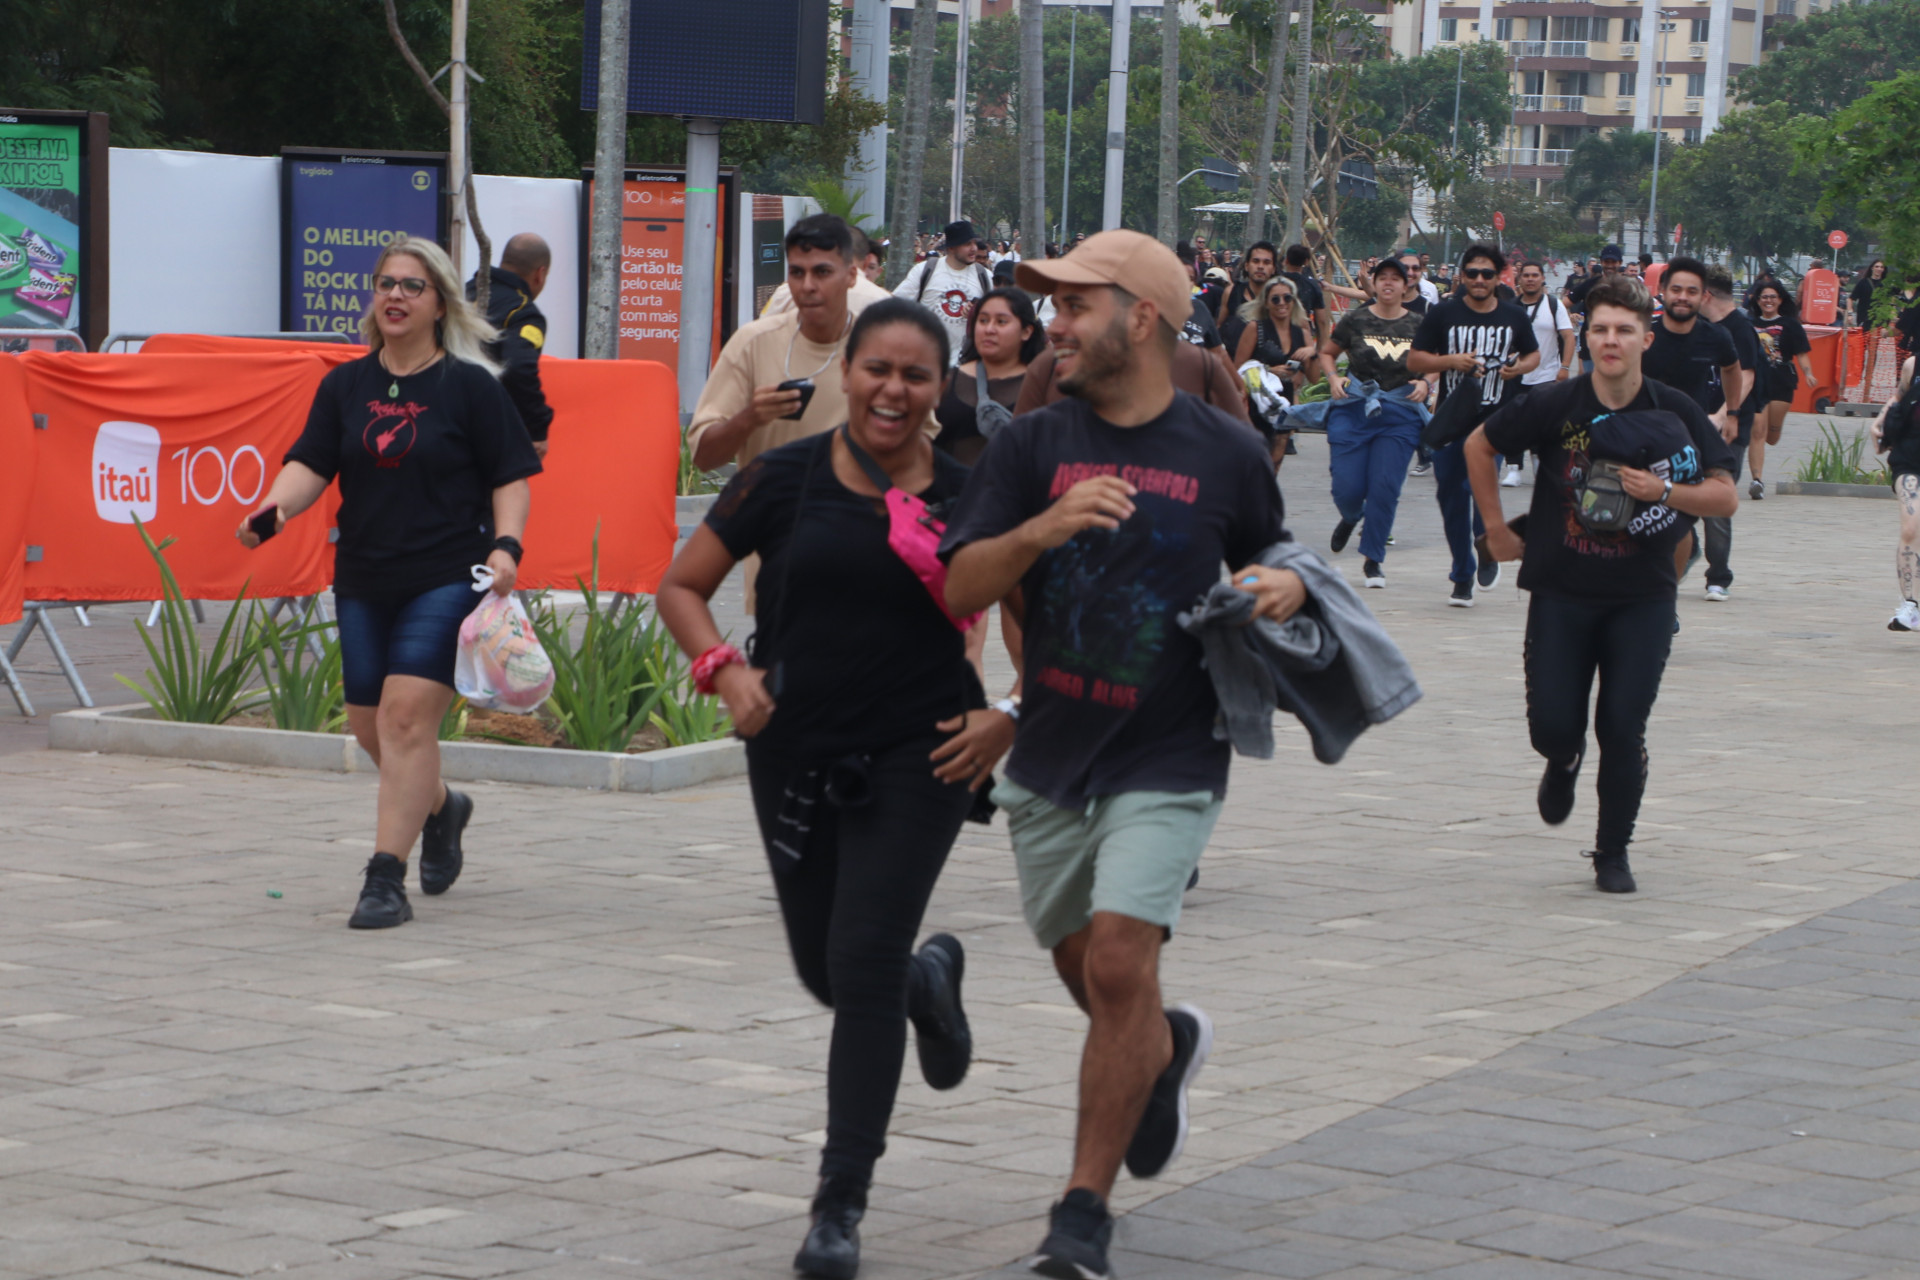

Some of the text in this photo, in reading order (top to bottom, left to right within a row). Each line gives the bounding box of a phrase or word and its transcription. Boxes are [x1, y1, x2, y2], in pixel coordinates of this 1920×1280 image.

[625, 190, 653, 204] 100
[304, 227, 320, 244] O
[25, 236, 58, 262] Trident
[303, 248, 334, 266] DO
[621, 245, 669, 258] Use seu
[621, 260, 683, 274] Cartão Ita
[30, 276, 60, 293] ident
[303, 270, 359, 290] ROCK
[621, 276, 682, 292] pelo celula
[303, 289, 362, 312] TÁ NA
[620, 294, 663, 306] e curta
[303, 314, 367, 334] TV GLO
[620, 309, 678, 322] com mais
[619, 326, 680, 343] seguranç
[98, 444, 265, 506] itaú 100
